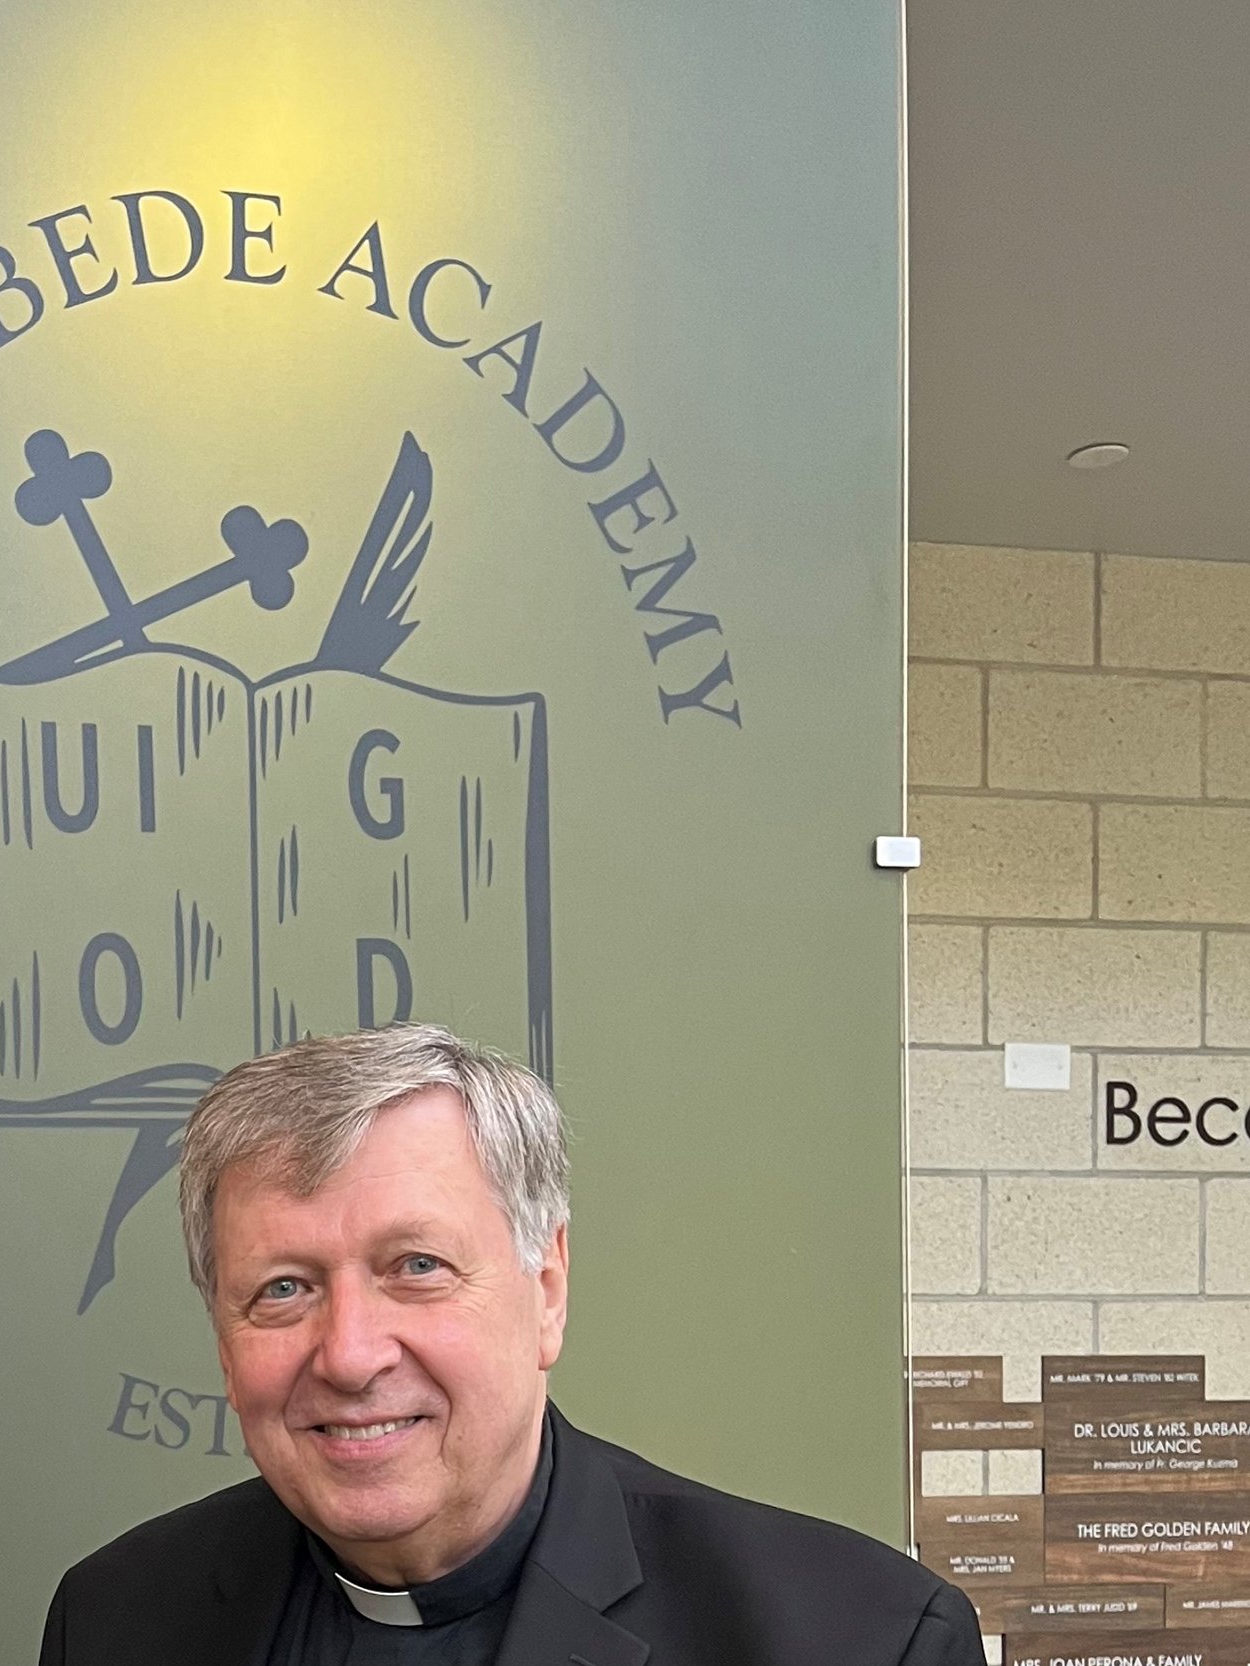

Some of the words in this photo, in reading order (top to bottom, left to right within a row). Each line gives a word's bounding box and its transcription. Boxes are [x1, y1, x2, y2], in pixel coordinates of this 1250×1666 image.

[318, 221, 742, 730] ACADEMY
[349, 729, 405, 841] G
[79, 933, 143, 1046] O
[356, 938, 413, 1030] D
[1106, 1081, 1250, 1148] Bec
[1074, 1423, 1097, 1438] DR.
[1100, 1421, 1139, 1438] LOUIS
[1143, 1423, 1153, 1437] &
[1157, 1421, 1190, 1437] MRS.
[1130, 1438, 1202, 1454] LUKANCIC
[1077, 1523, 1101, 1538] THE
[1104, 1522, 1138, 1538] FRED
[1141, 1521, 1201, 1537] GOLDEN
